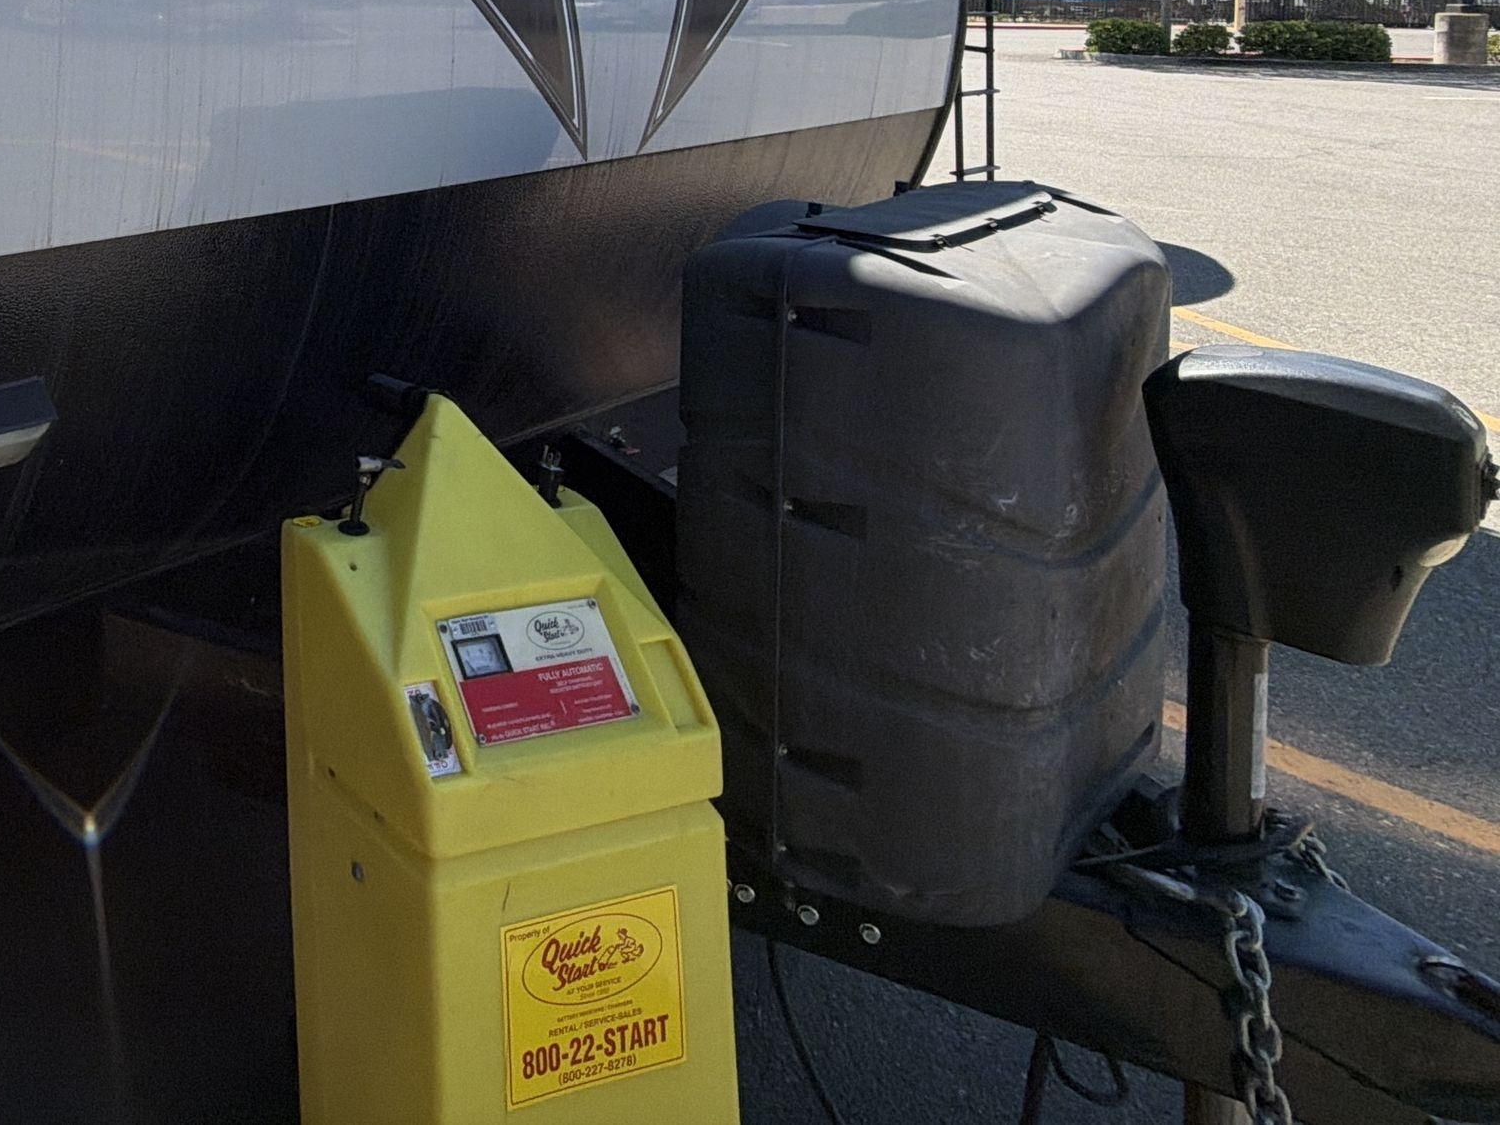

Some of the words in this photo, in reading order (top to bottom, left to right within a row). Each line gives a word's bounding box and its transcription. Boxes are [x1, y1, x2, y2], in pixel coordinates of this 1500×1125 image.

[534, 616, 560, 636] Quick
[543, 628, 560, 644] Start
[538, 670, 561, 682] FULLY
[561, 662, 604, 678] AUTOMATIC
[509, 930, 541, 943] Property
[542, 925, 550, 935] of
[541, 924, 603, 976] Quick
[552, 954, 599, 992] Start
[576, 983, 595, 994] YOUR
[594, 976, 623, 989] SERVICE
[548, 1024, 578, 1038] RENTAL
[521, 1013, 670, 1080] 800-22-START
[558, 1053, 638, 1087] (800-227-8278)
